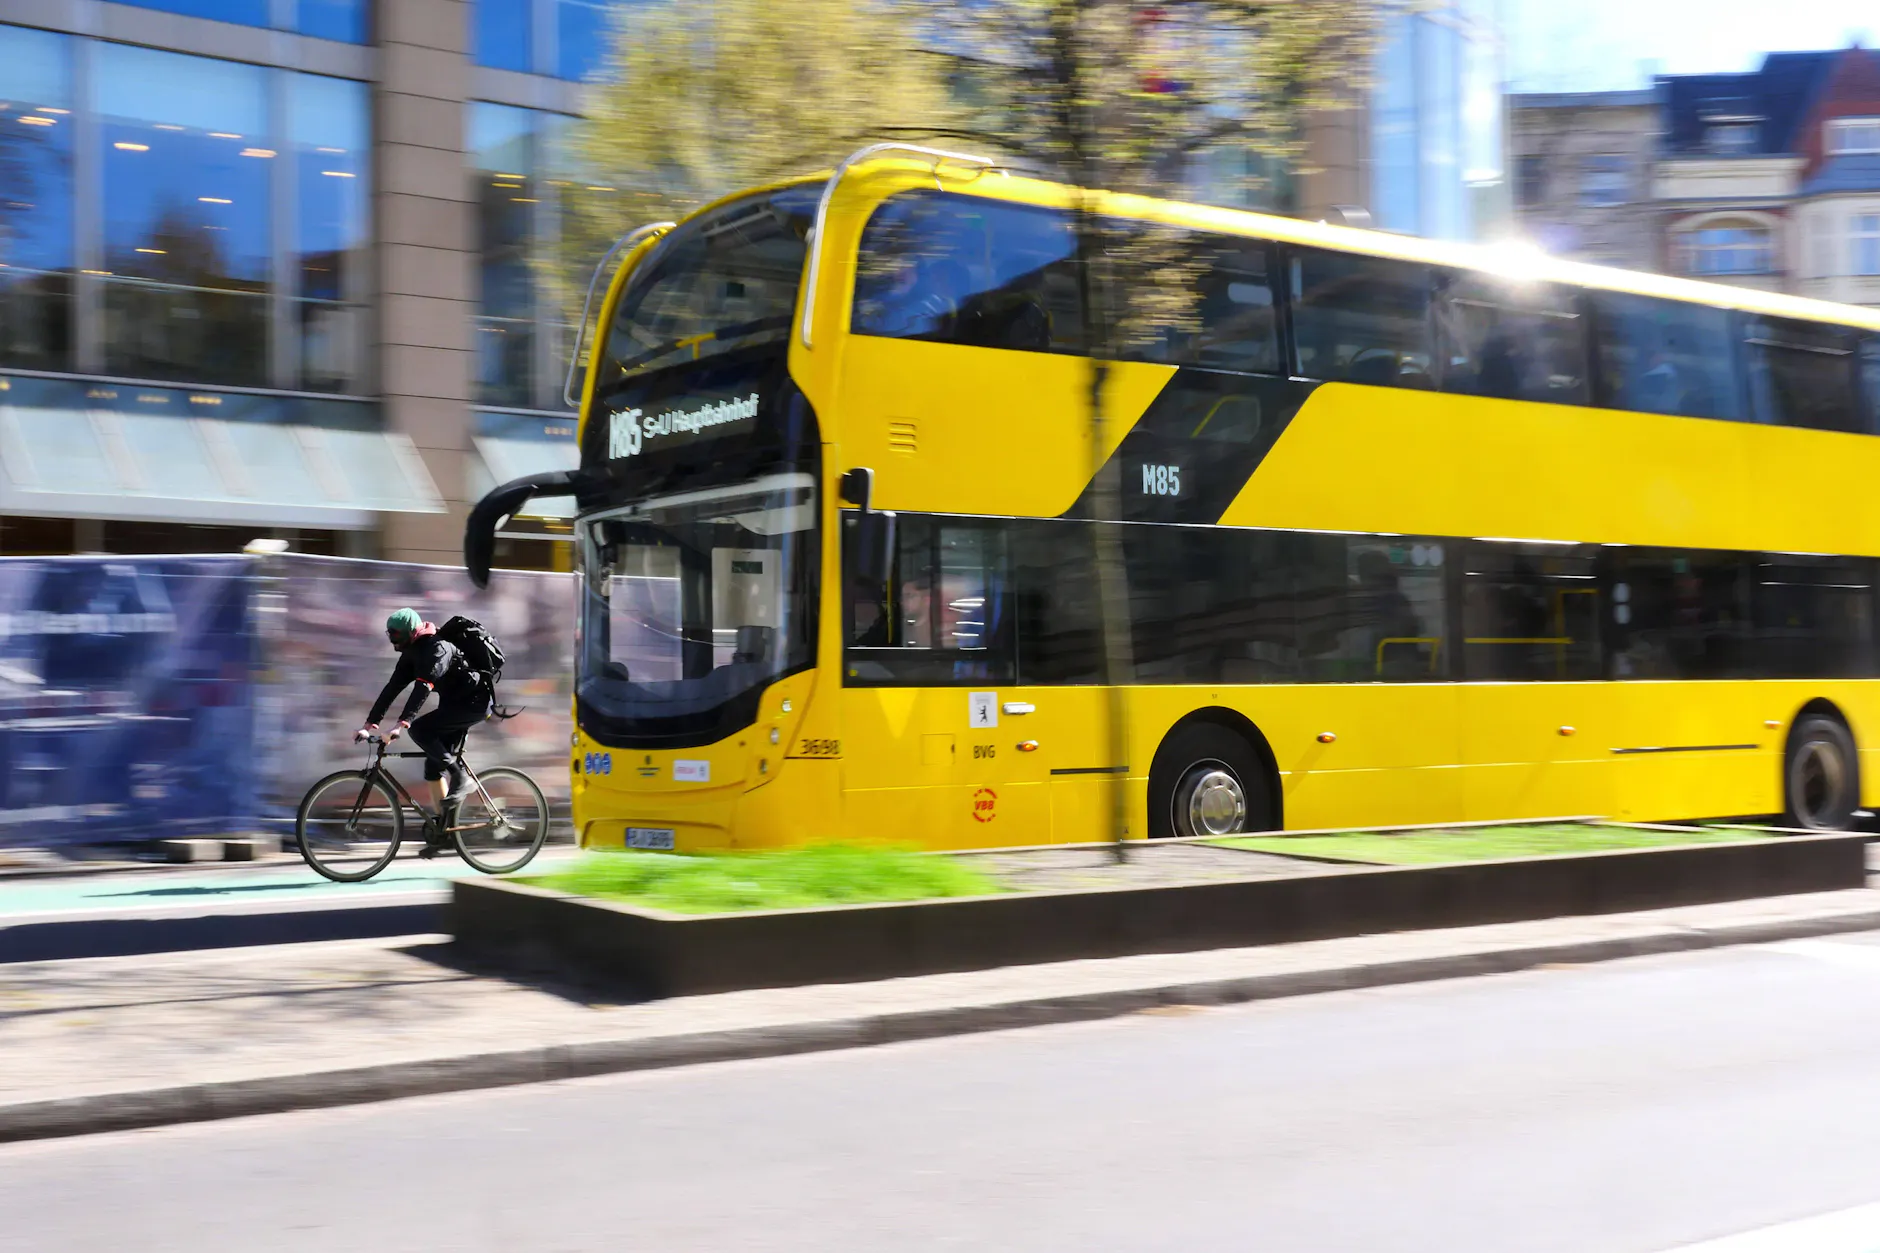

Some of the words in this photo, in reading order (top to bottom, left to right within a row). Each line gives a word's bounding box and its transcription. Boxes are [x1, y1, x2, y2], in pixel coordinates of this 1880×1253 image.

[609, 408, 643, 460] M85
[1142, 464, 1180, 496] M85
[800, 738, 841, 755] 3698
[973, 745, 996, 759] BVG
[975, 800, 995, 811] VBB
